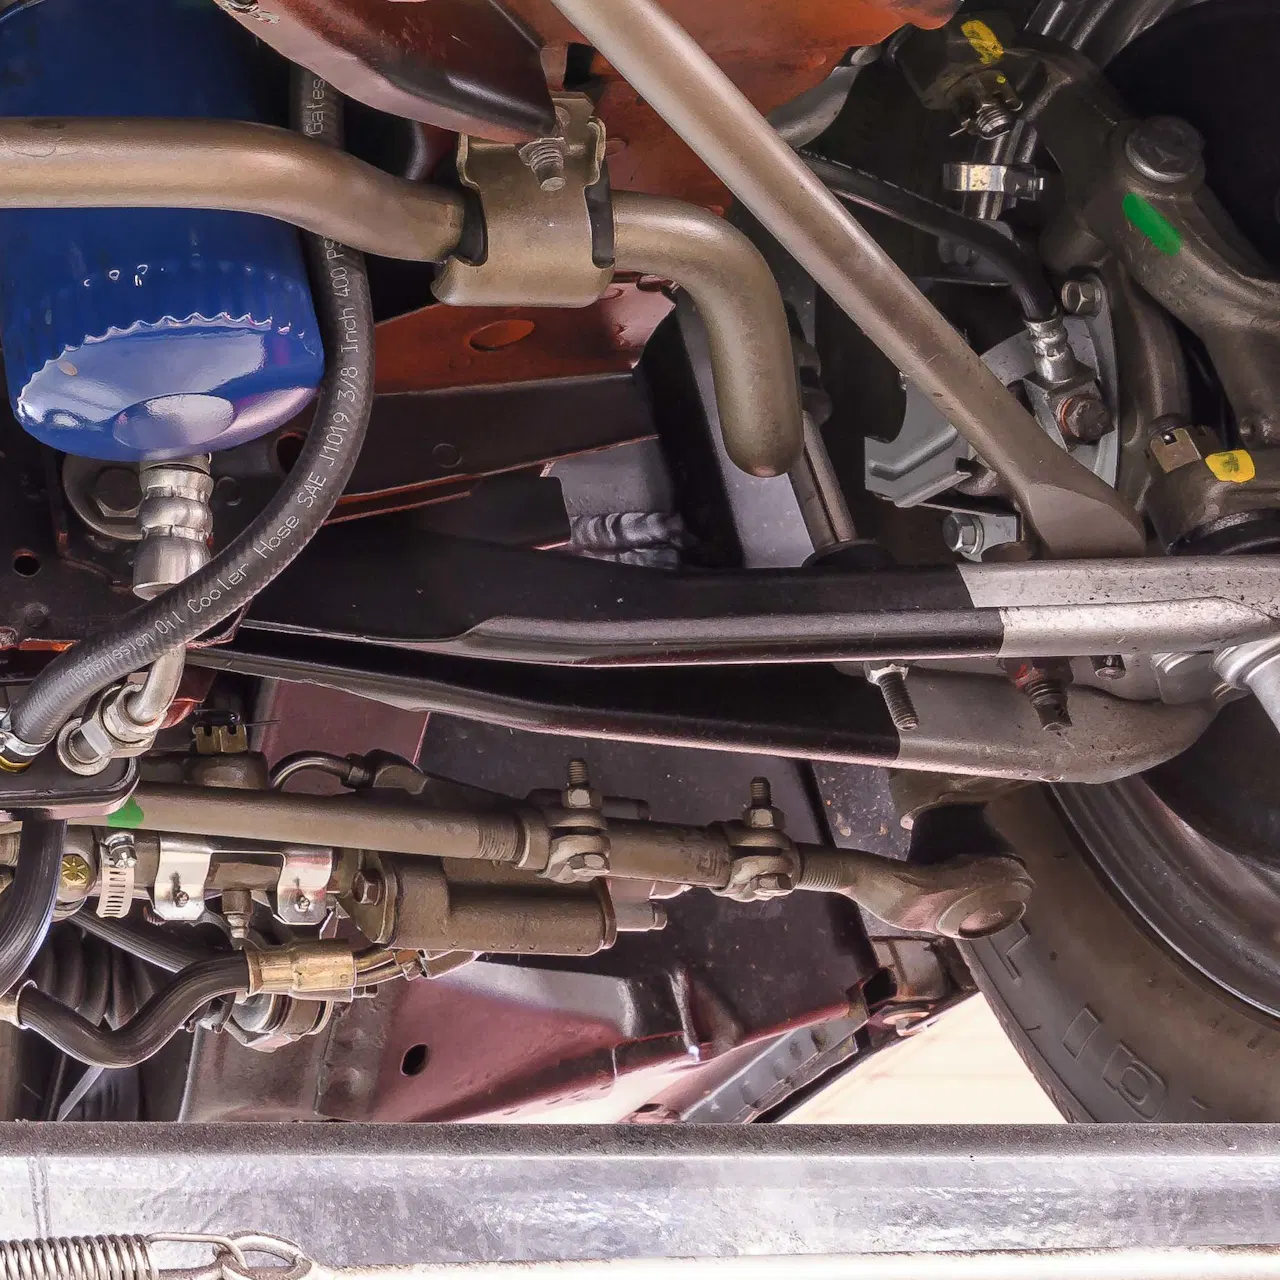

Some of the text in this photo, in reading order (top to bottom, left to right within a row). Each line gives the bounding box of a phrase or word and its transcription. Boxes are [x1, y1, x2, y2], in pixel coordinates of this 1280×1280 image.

[305, 78, 325, 137] Gates
[68, 235, 360, 683] Transmission Oil Cooler Hose SAE J1019 3/8 Inch 400 PS
